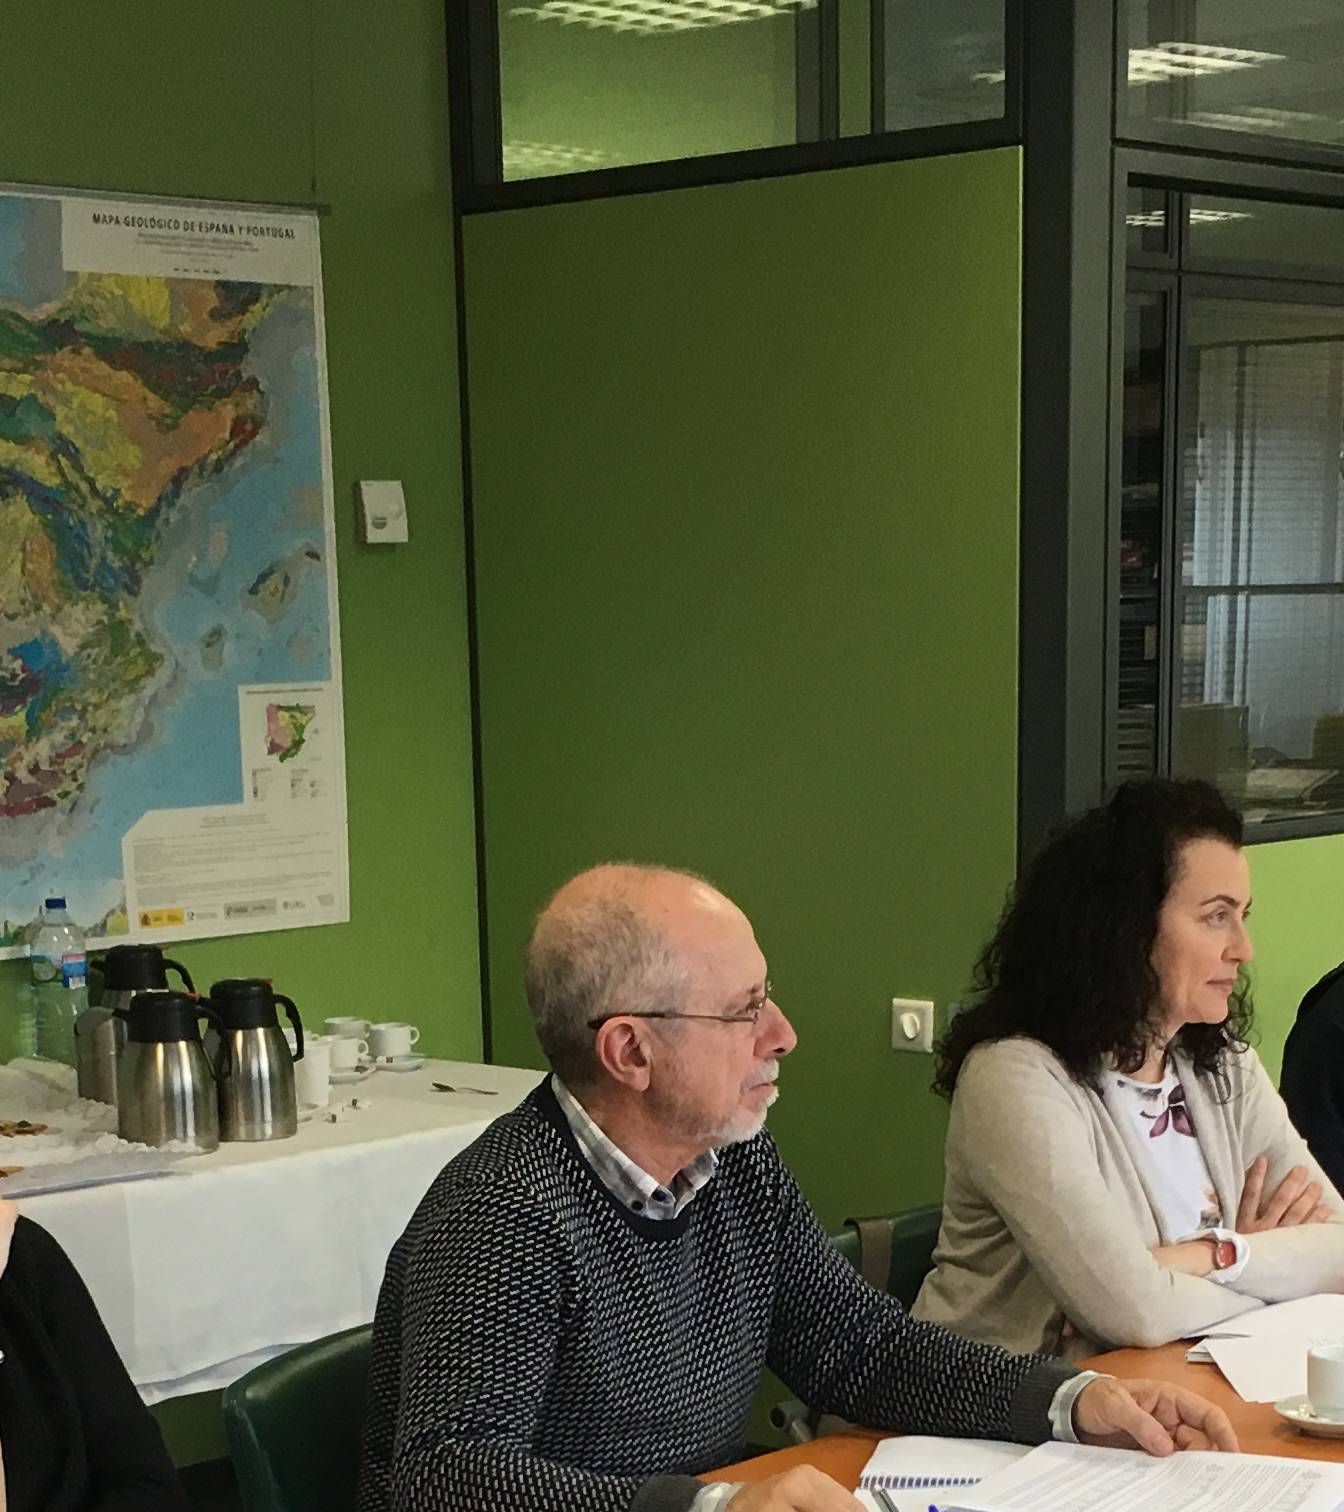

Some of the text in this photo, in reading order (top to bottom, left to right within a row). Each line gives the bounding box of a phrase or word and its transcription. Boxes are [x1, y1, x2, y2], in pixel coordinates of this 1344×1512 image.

[92, 213, 121, 226] MAPA
[183, 220, 196, 232] DE
[238, 224, 244, 234] Y
[246, 225, 296, 240] PORTUGAL
